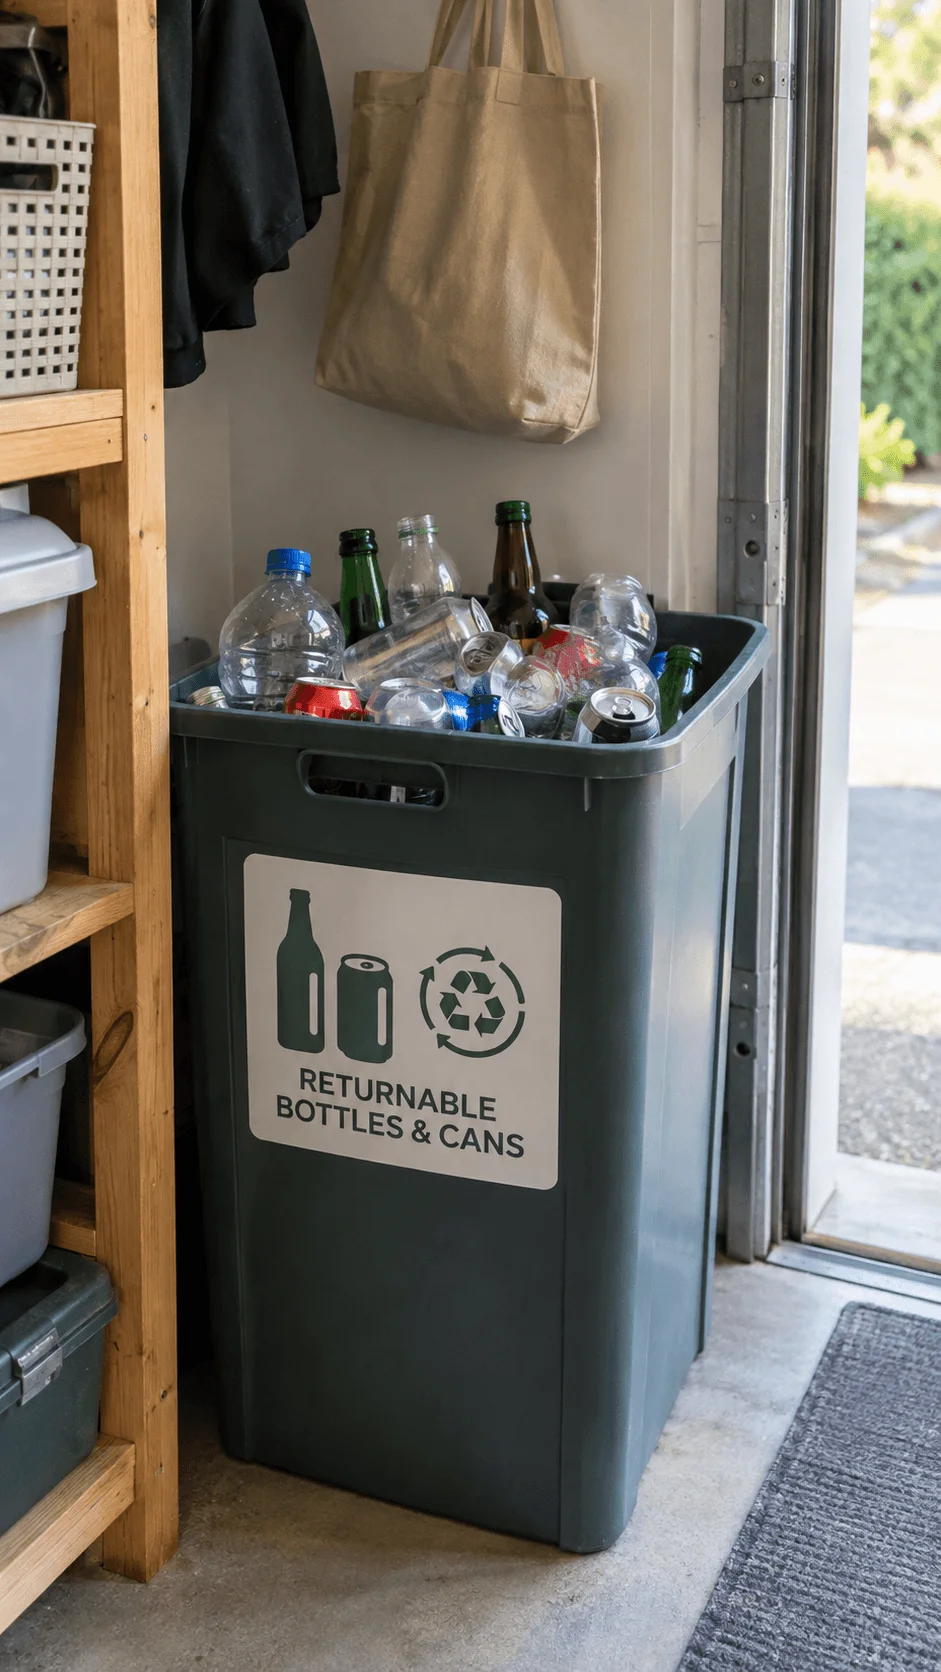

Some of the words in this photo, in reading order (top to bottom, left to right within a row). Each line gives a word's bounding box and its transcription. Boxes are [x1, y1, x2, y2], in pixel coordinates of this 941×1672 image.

[299, 1067, 497, 1122] RETURNABLE
[276, 1094, 404, 1139] BOTTLES
[411, 1118, 432, 1145] &
[439, 1123, 525, 1159] CANS
